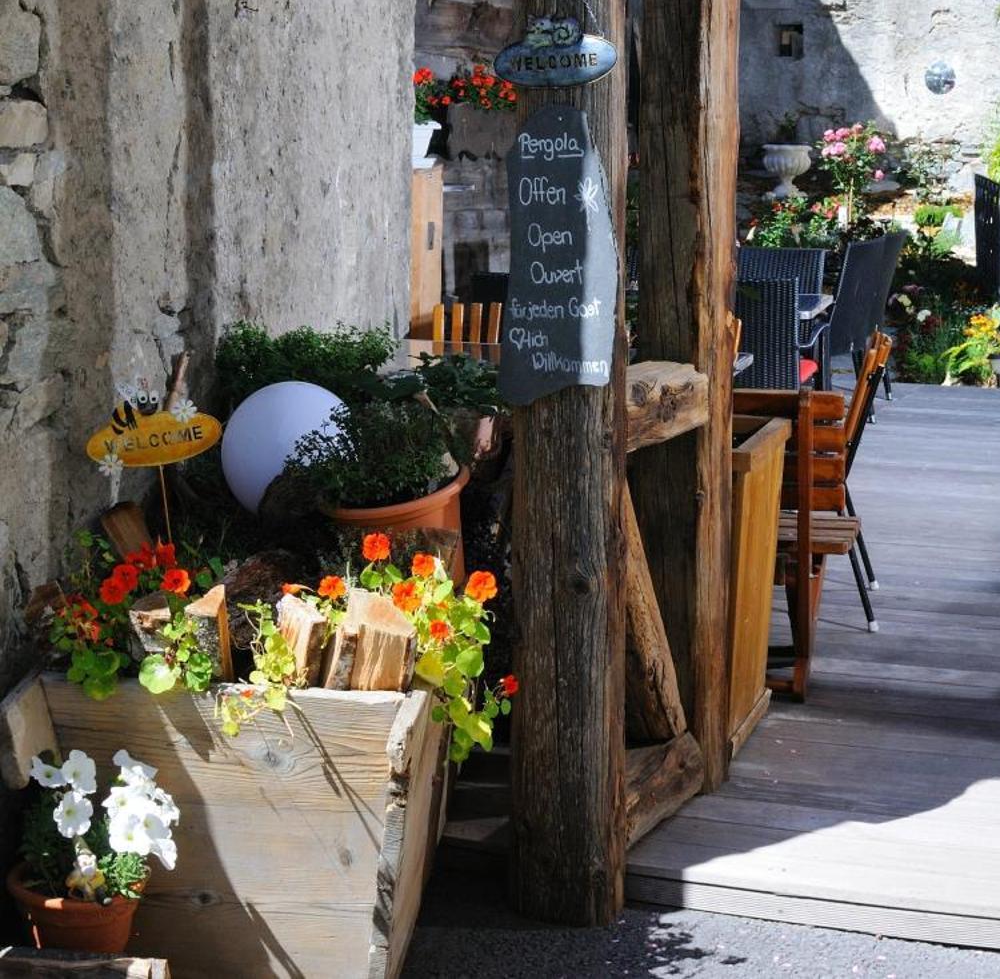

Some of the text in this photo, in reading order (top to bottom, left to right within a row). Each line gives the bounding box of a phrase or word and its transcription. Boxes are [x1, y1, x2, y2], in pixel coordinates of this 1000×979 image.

[510, 52, 598, 72] WELCOME
[518, 132, 582, 161] Pergola
[519, 176, 566, 205] Offen
[528, 223, 572, 253] Open
[531, 259, 583, 284] Ouvert
[532, 351, 609, 377] Willkommen
[104, 426, 204, 454] WELCOME
